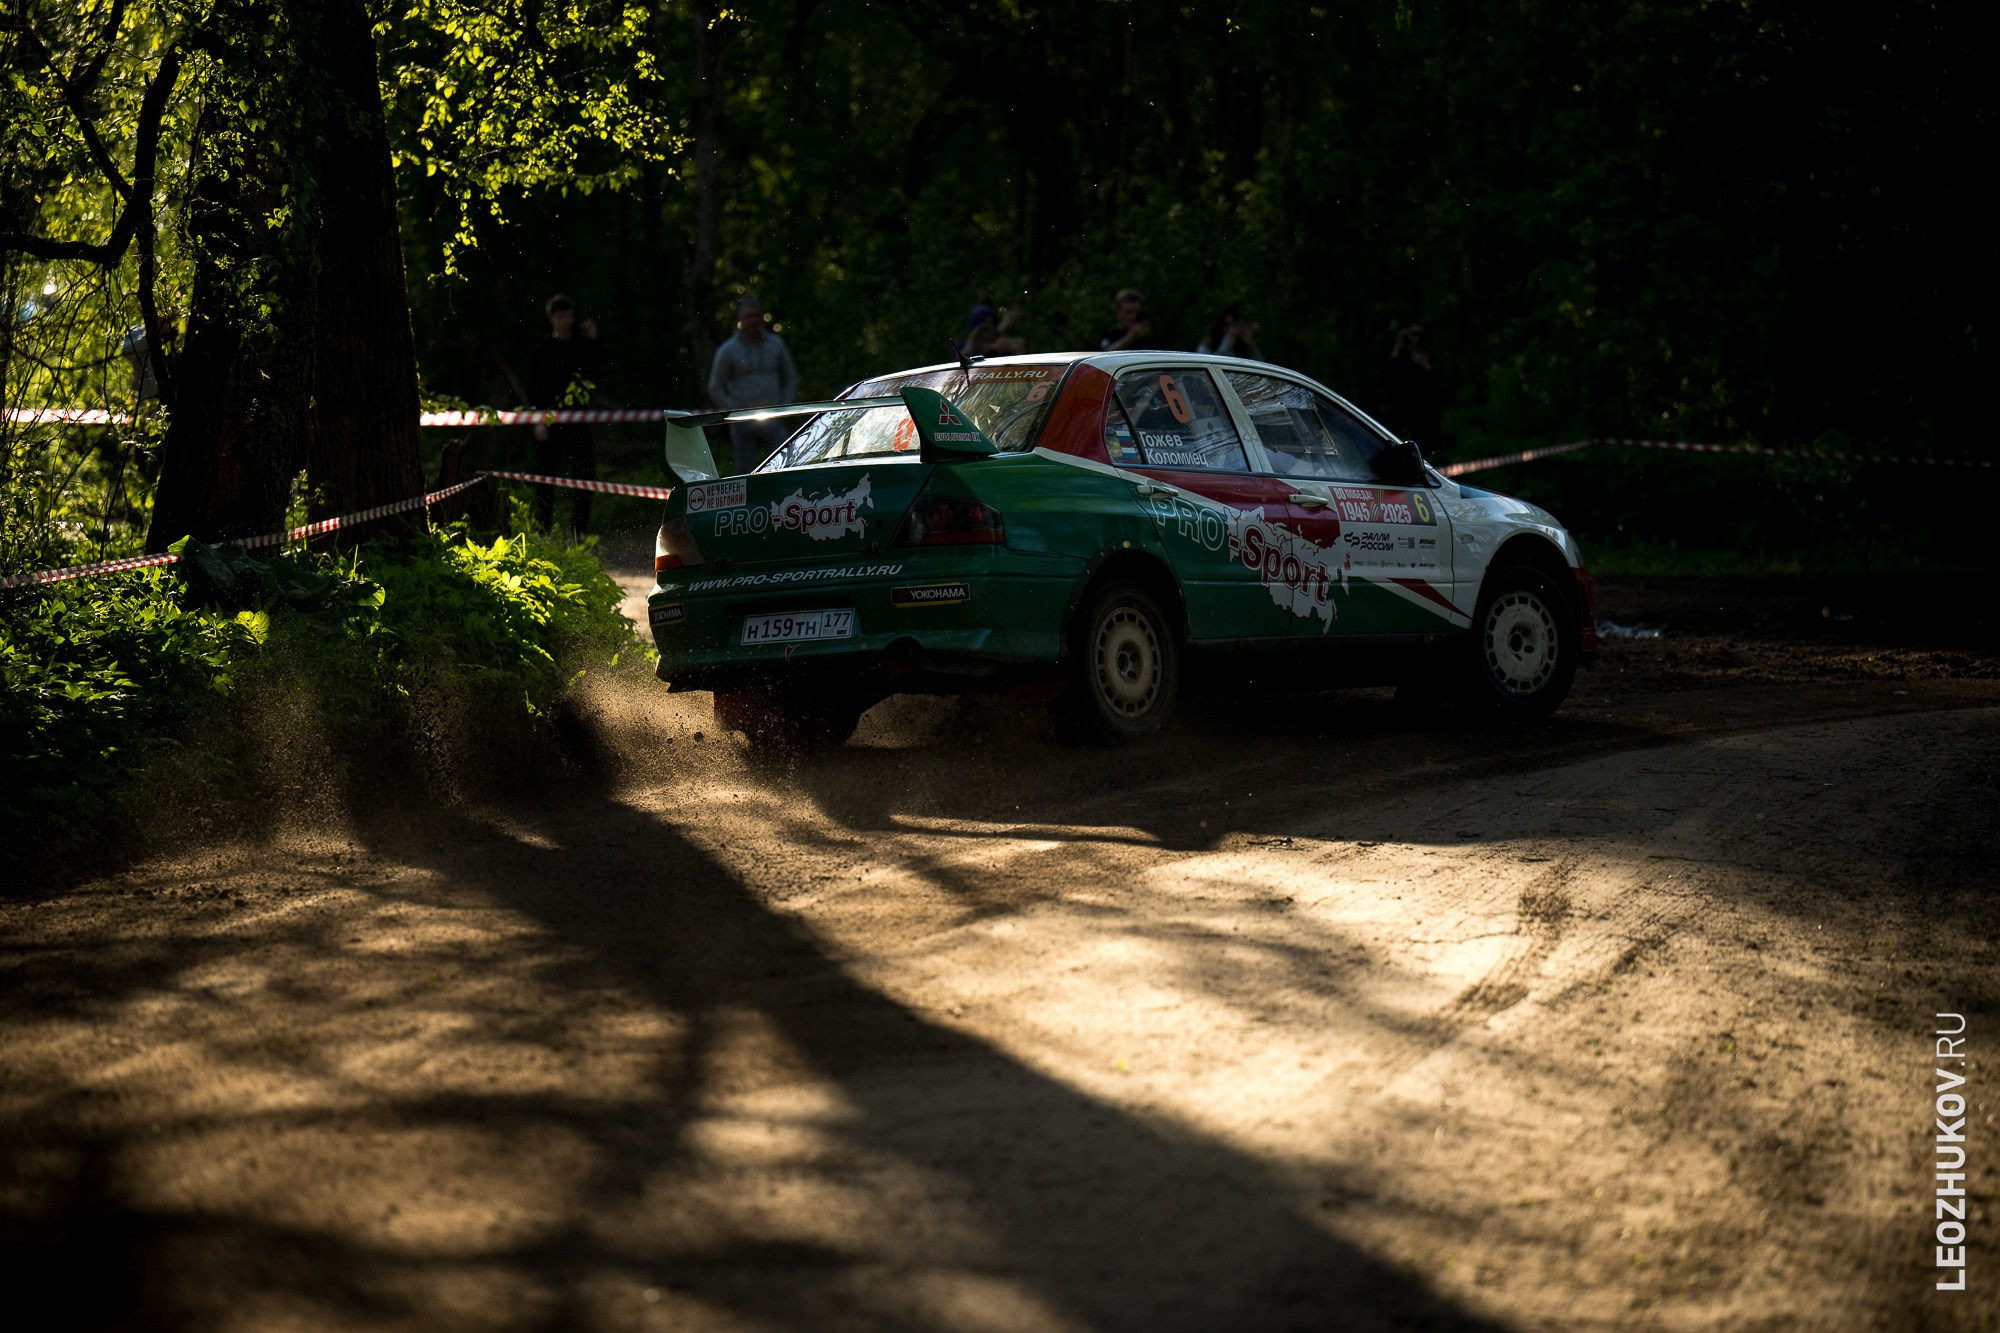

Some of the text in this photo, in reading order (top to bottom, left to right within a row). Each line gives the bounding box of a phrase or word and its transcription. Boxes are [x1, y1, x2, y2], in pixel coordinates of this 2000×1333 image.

[1027, 383, 1052, 402] 6
[1158, 375, 1191, 424] 6
[934, 432, 971, 442] EVOLUTION
[1144, 448, 1209, 467] Коломиец
[706, 485, 715, 496] НЕ
[1334, 488, 1346, 500] 80
[706, 498, 714, 509] НЕ
[1413, 493, 1430, 524] 6
[1341, 502, 1370, 522] 1945
[1380, 503, 1412, 524] 2025
[1362, 532, 1390, 541] РАЛЛИ
[1361, 542, 1394, 551] РОССИИ
[688, 564, 903, 591] WWW.PRO-SPORTRALLY.RU
[910, 587, 966, 600] YOKOHAMA
[824, 612, 851, 628] 177
